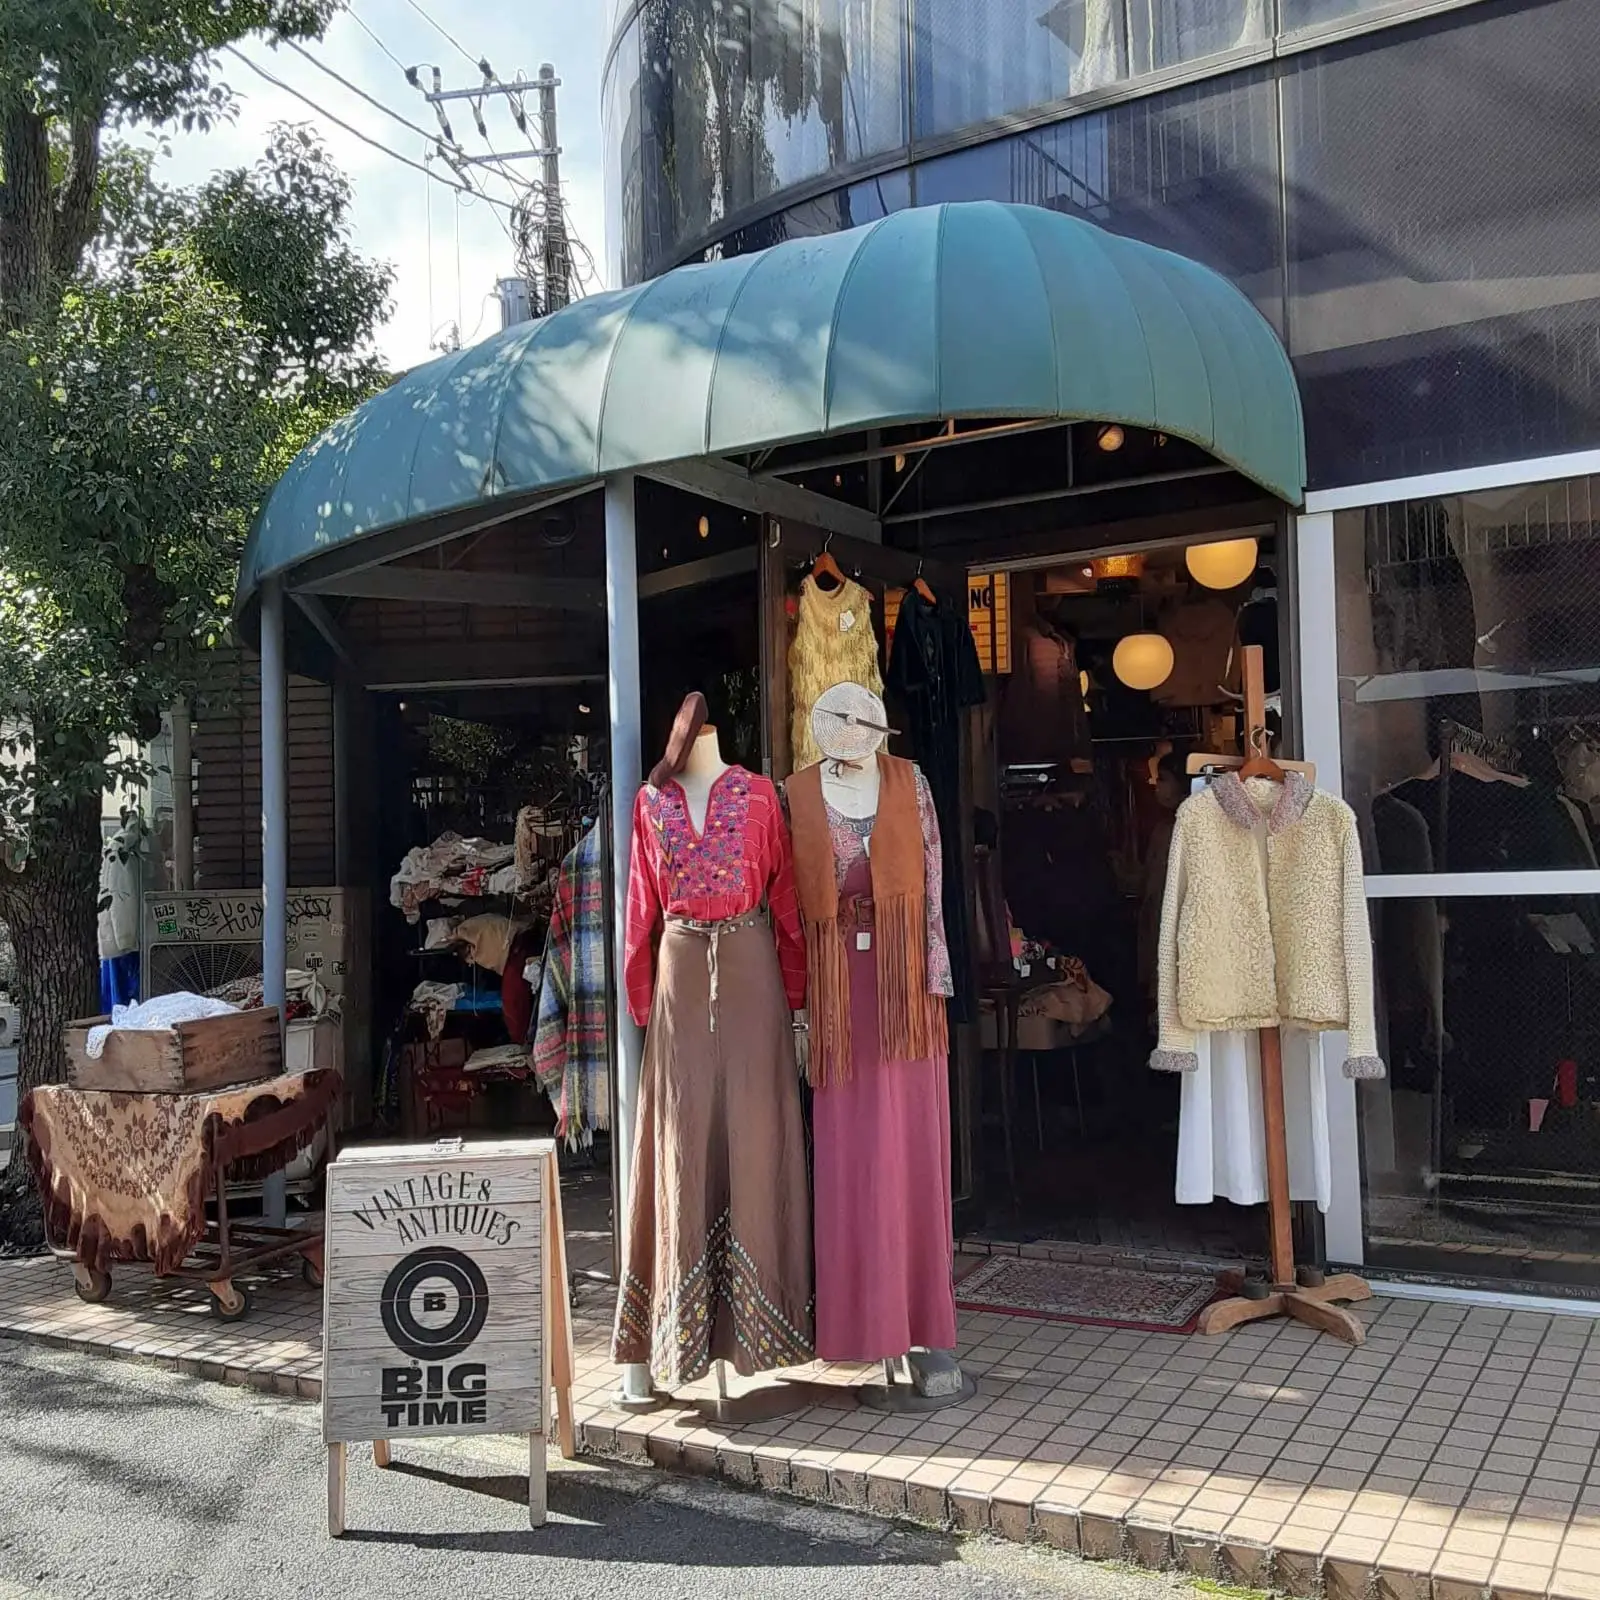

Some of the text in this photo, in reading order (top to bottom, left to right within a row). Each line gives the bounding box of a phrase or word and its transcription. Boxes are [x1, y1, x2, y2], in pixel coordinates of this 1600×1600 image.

[397, 1203, 521, 1246] ANTIQUES
[423, 1292, 447, 1312] B
[381, 1363, 487, 1401] BIG
[381, 1400, 487, 1427] TIME
